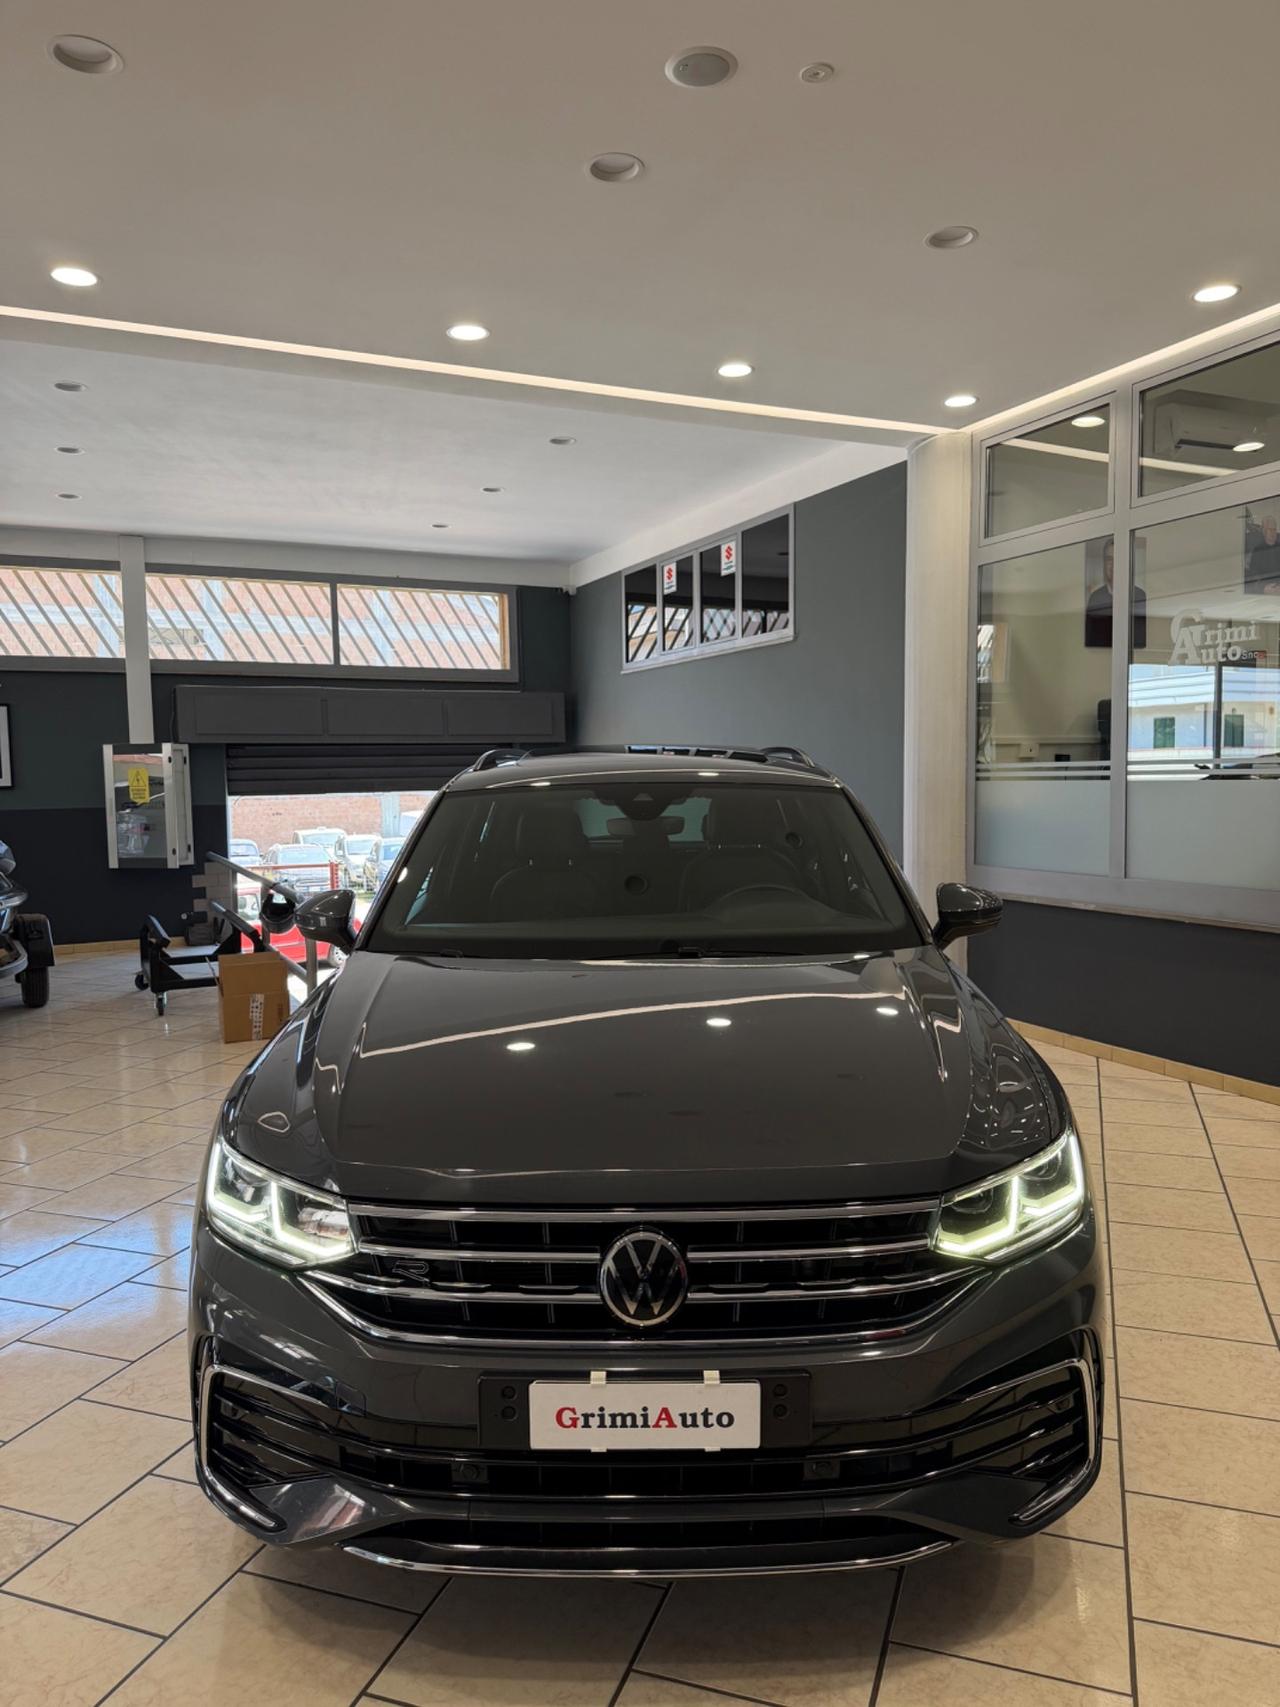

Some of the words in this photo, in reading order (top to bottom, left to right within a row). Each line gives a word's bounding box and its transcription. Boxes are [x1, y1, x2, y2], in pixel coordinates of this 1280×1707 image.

[1170, 608, 1257, 646] Grimi
[1168, 627, 1241, 666] Auto
[555, 1406, 735, 1428] GrimiAuto
